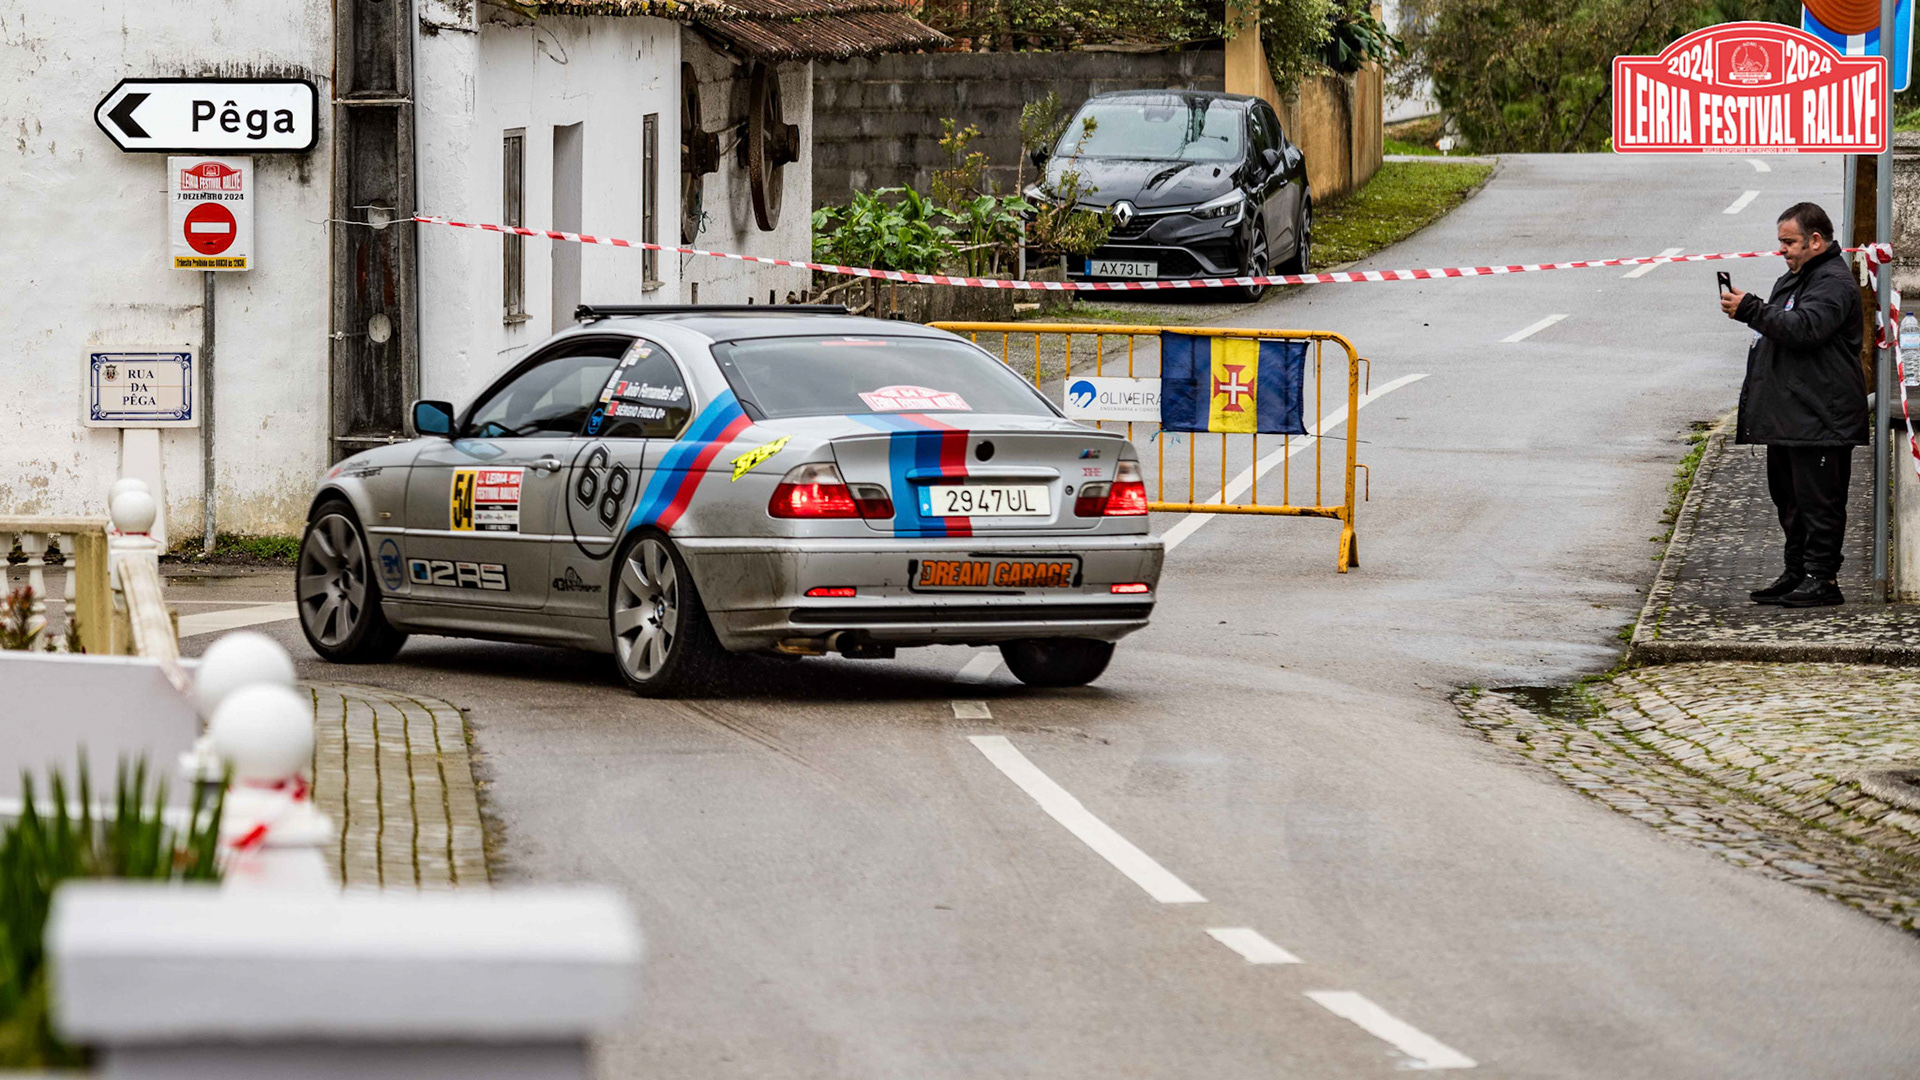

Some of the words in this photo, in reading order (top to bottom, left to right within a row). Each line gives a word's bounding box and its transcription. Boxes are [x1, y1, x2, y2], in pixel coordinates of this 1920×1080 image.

[192, 100, 295, 139] Pêga
[183, 192, 222, 200] DEZEMBRO
[128, 370, 154, 379] RUA
[131, 383, 148, 392] DA
[122, 393, 156, 405] PÊGA
[576, 443, 630, 532] 68
[454, 474, 474, 528] 54
[920, 560, 991, 587] DREAM
[993, 562, 1073, 588] GARAGE
